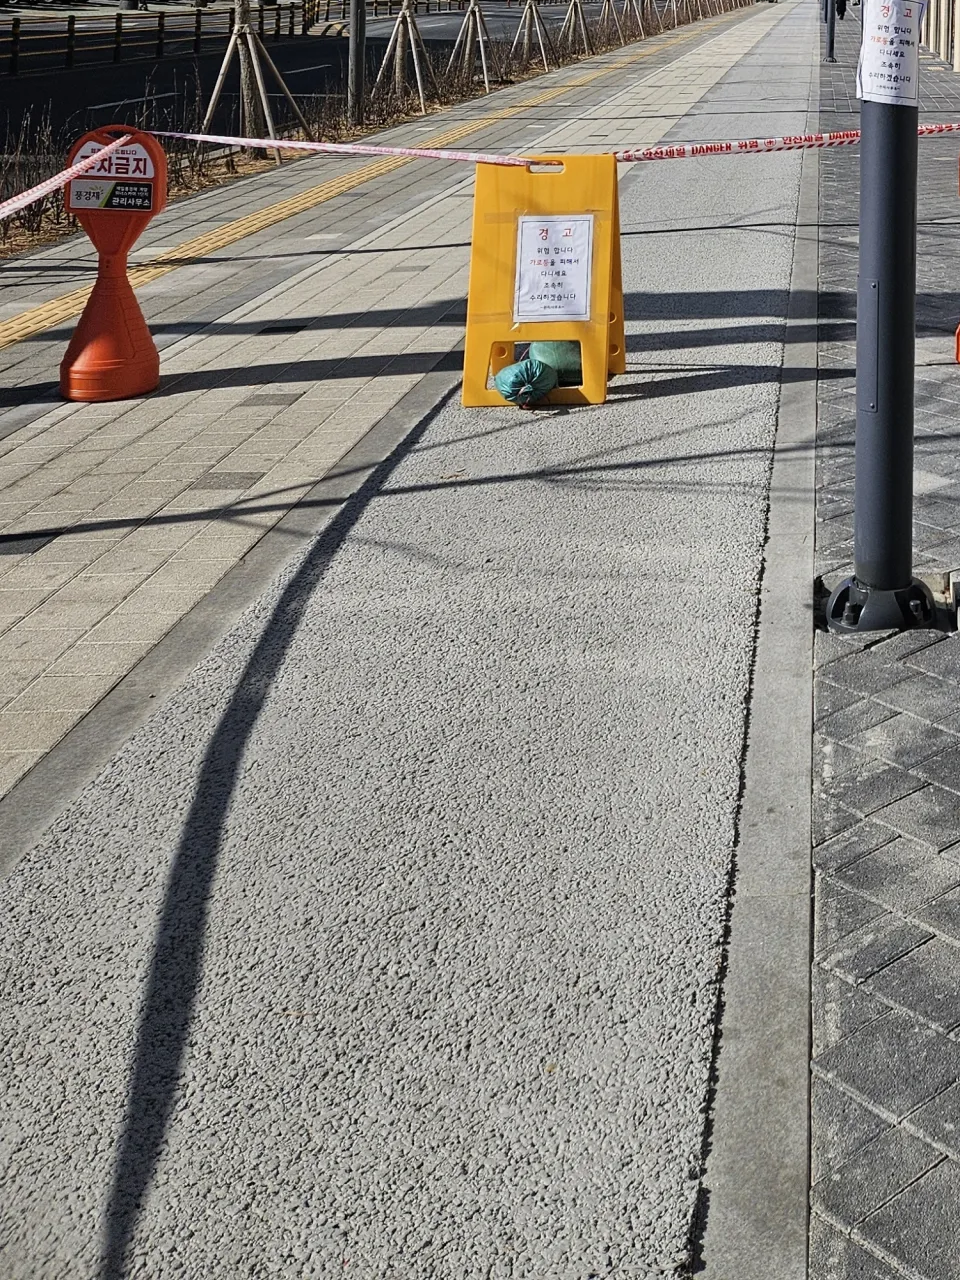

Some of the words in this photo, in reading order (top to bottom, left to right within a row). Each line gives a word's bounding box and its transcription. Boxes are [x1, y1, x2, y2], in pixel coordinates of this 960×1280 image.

[894, 26, 912, 35] 합니다
[879, 49, 906, 58] 다니세요
[868, 72, 911, 83] 수리하겠습니다
[691, 143, 732, 155] DANGER
[737, 140, 758, 149] 위험
[74, 190, 101, 201] 풍경채
[112, 197, 150, 207] 관리사무소
[553, 247, 574, 255] 합니다
[529, 259, 556, 267] 가로등을
[529, 293, 576, 301] 수리하겠습니다
